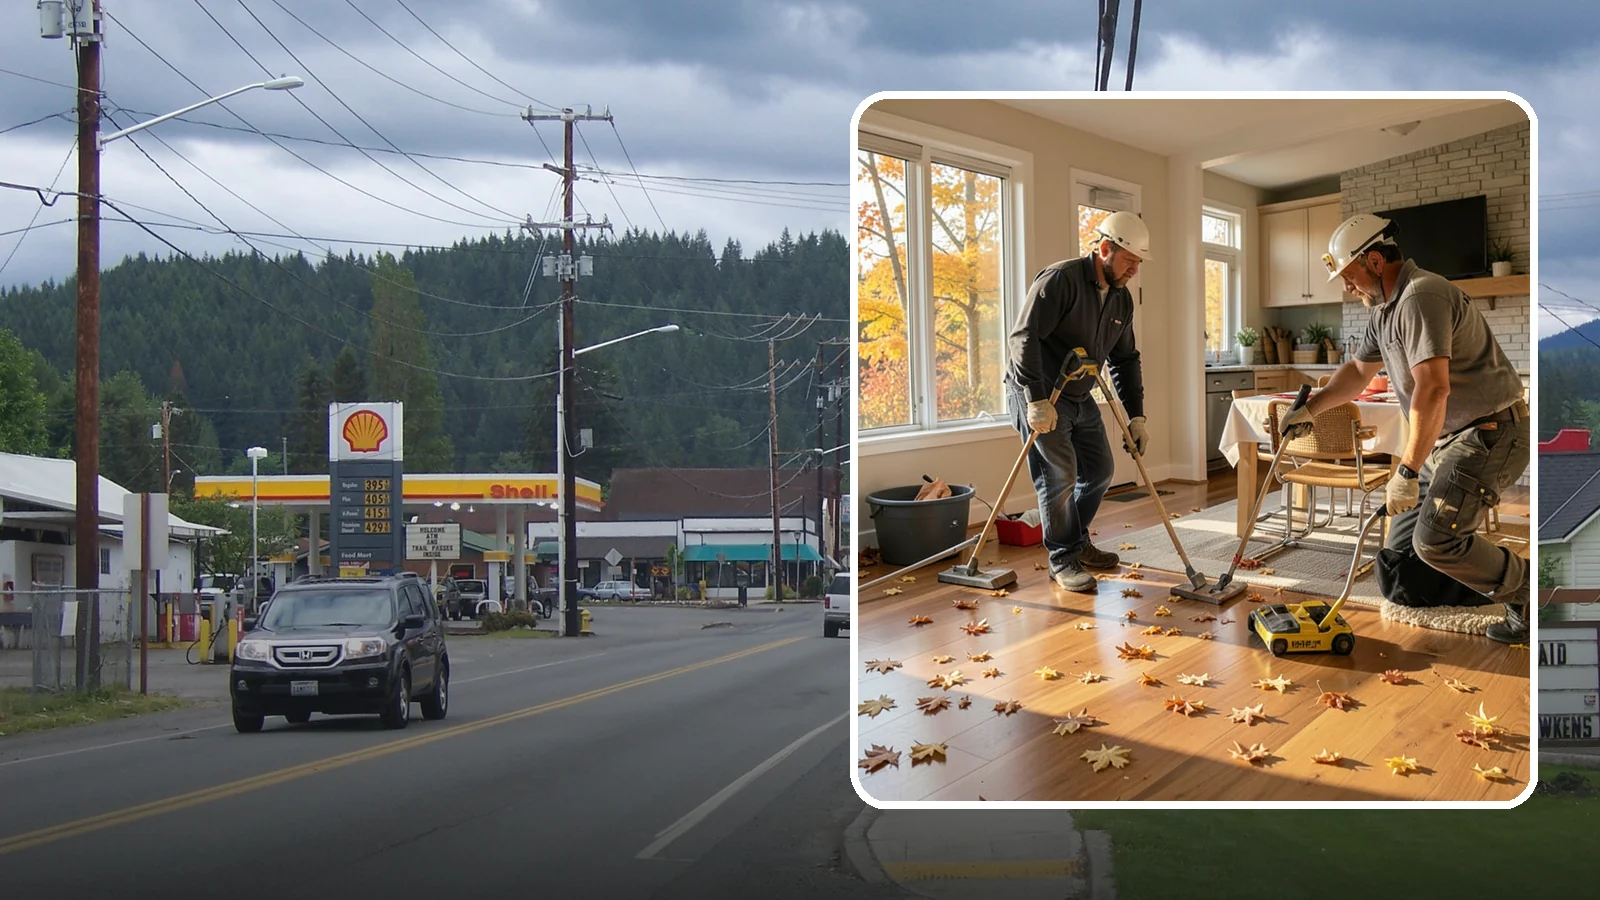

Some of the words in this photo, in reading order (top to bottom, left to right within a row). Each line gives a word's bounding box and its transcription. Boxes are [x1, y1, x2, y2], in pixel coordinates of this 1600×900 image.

[366, 480, 383, 490] 395
[490, 484, 547, 499] Shell
[366, 495, 383, 504] 405
[366, 508, 383, 518] 415
[366, 522, 383, 533] 429
[1538, 642, 1567, 666] AID
